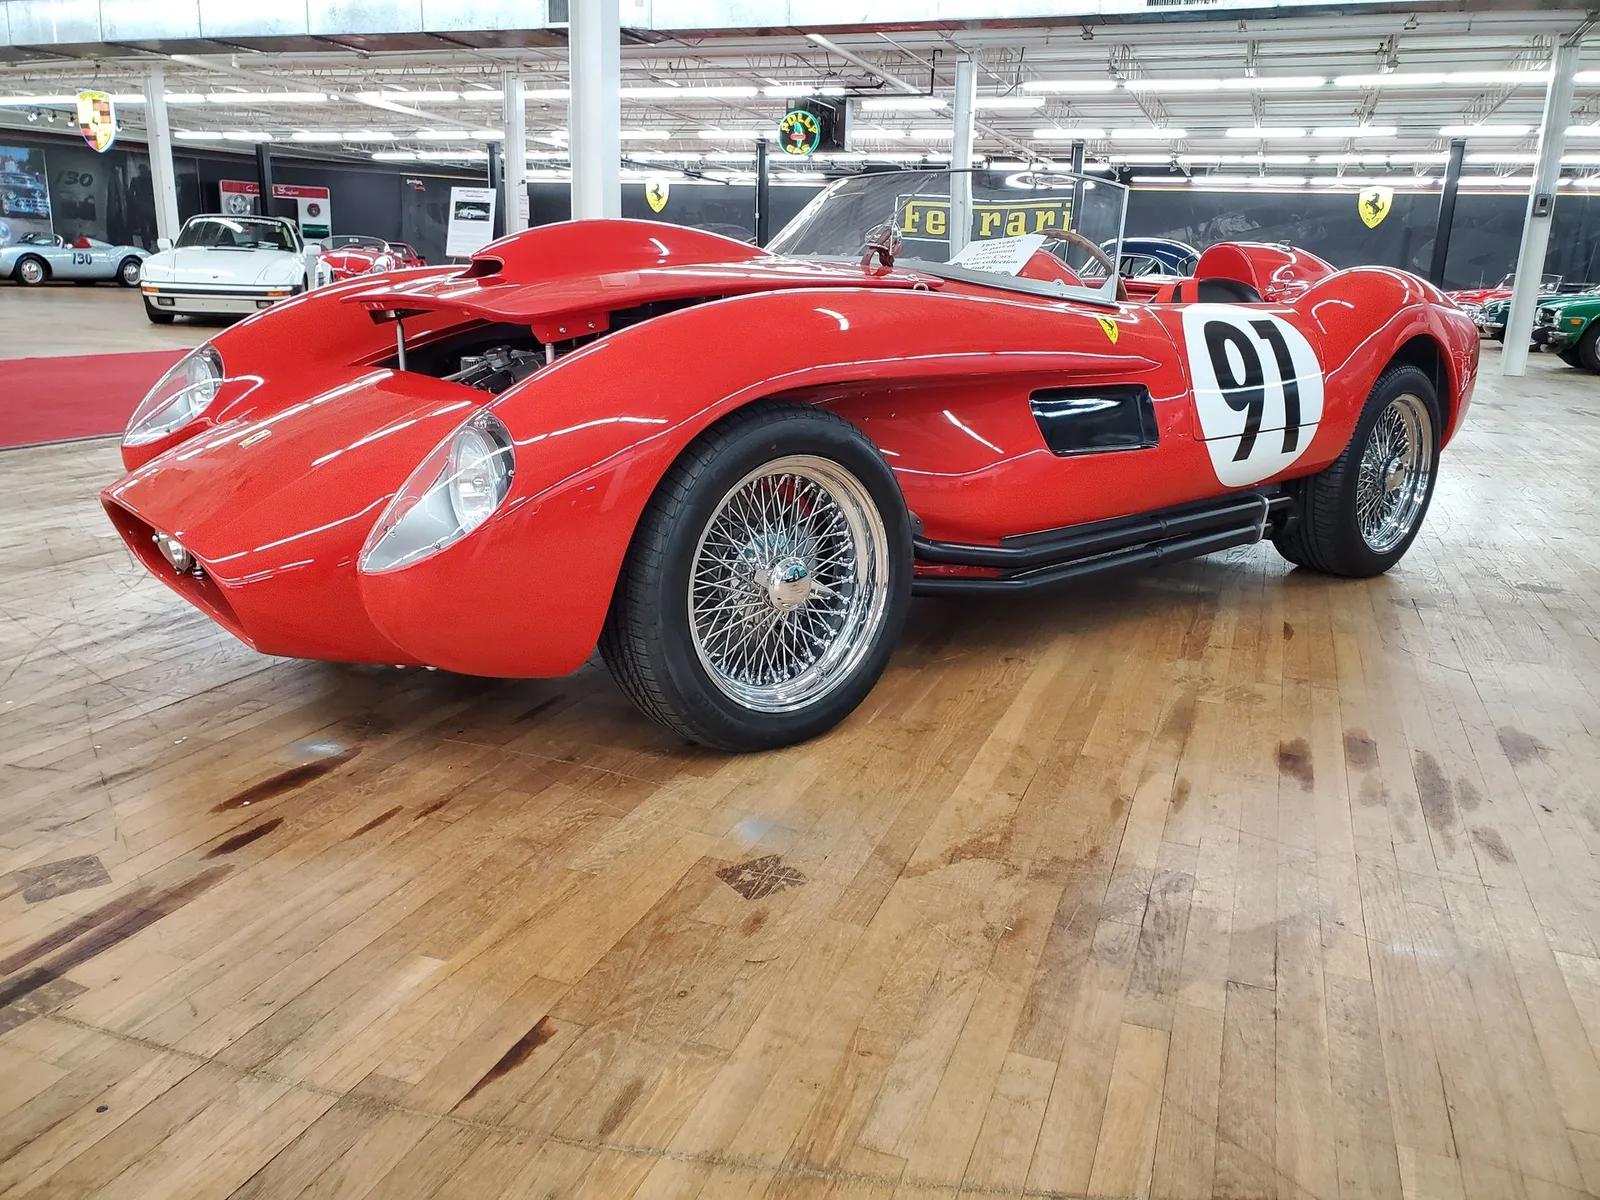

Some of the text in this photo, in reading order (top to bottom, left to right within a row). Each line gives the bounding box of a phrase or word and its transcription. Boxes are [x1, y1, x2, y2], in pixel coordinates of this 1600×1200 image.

[781, 113, 817, 133] POLLY
[786, 144, 810, 154] GAS
[901, 201, 1071, 237] Ferari
[72, 253, 92, 265] 130
[1203, 319, 1301, 462] 91
